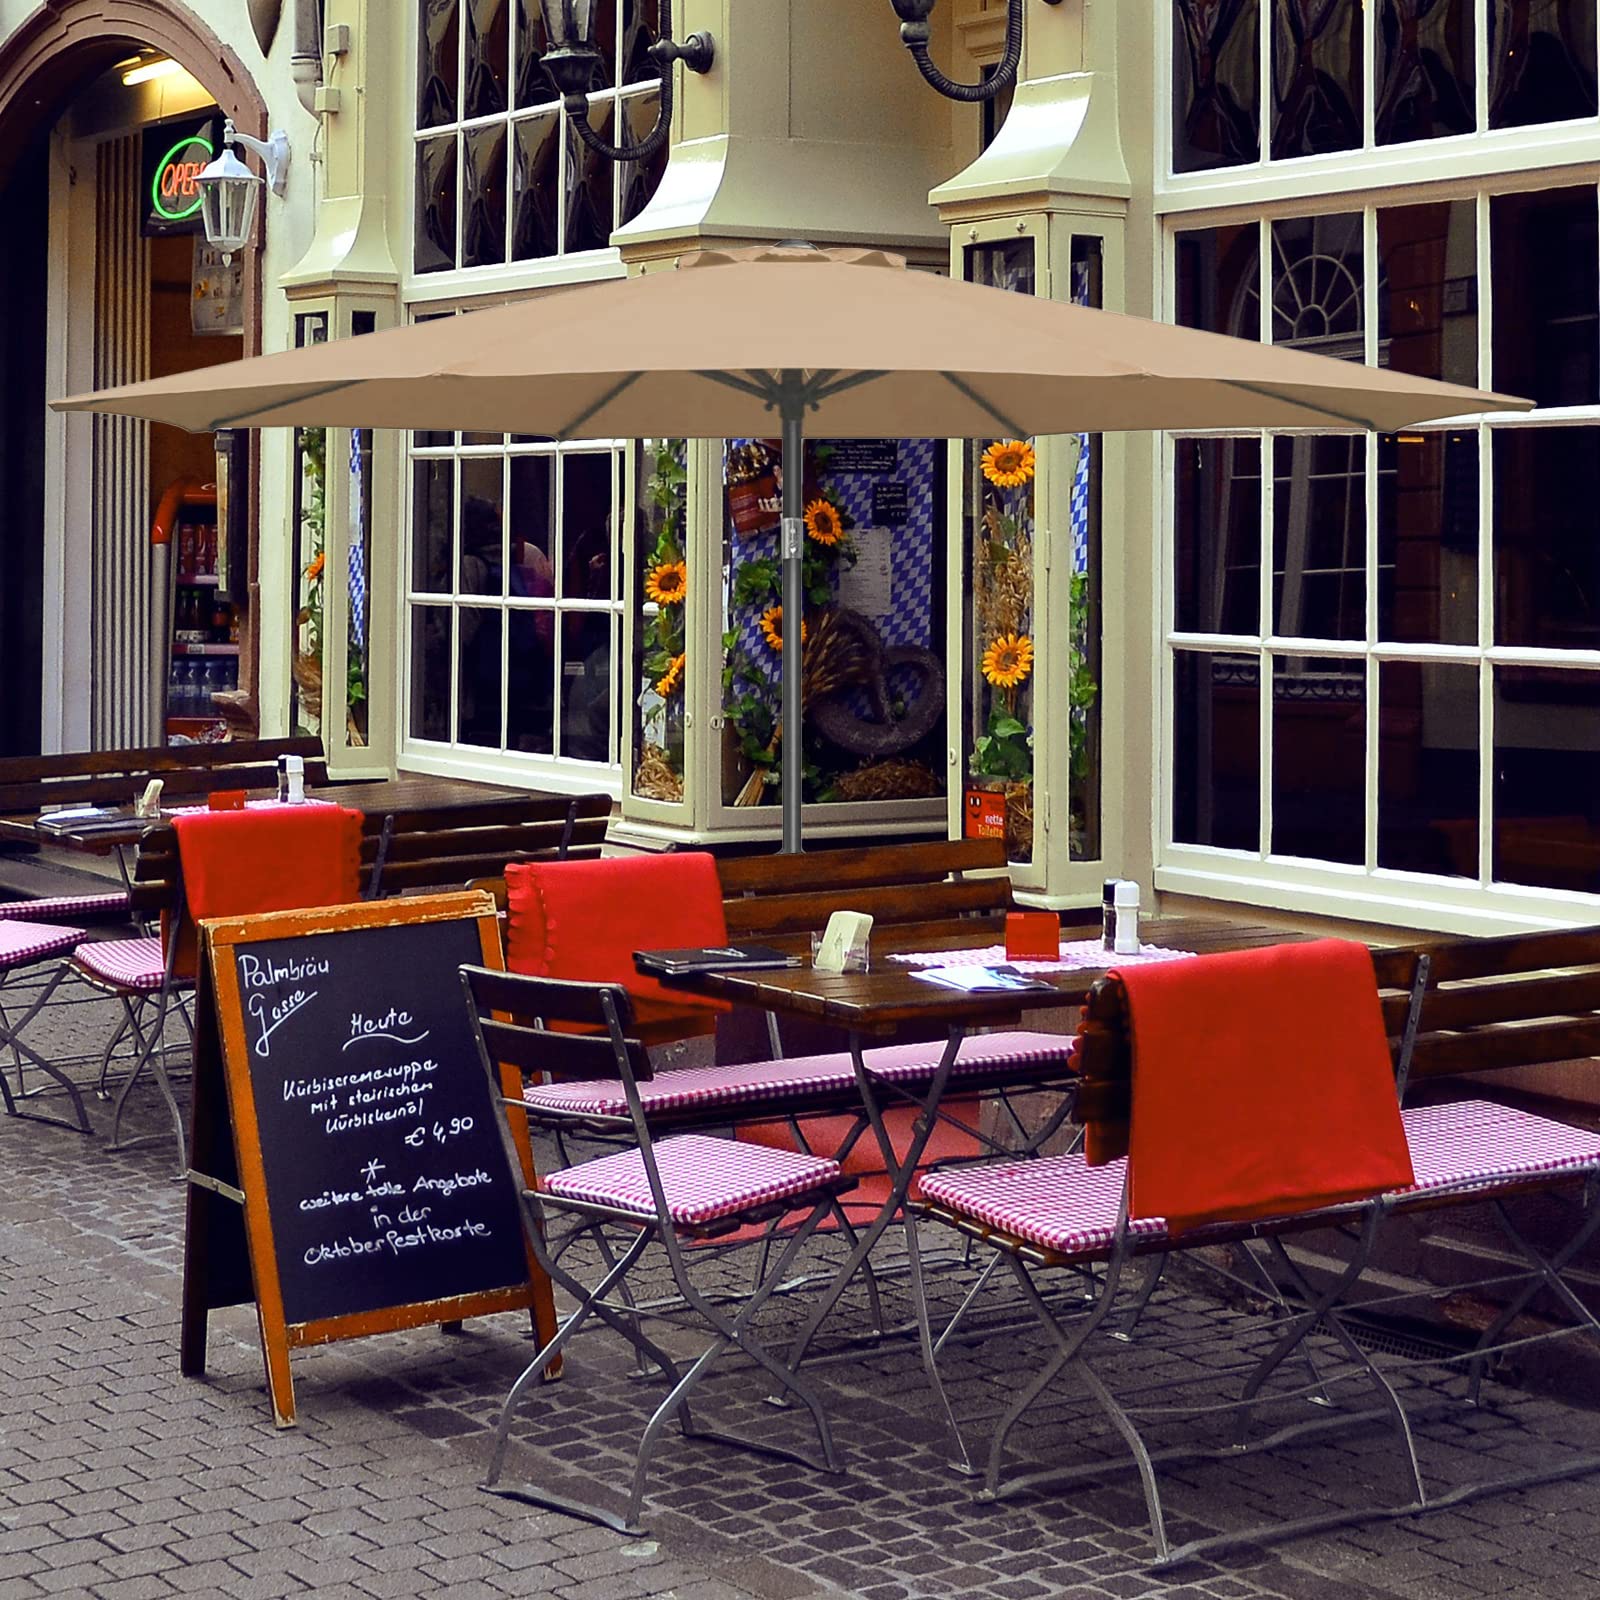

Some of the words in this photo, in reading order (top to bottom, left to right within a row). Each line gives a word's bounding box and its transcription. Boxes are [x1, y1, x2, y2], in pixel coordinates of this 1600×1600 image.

[238, 954, 329, 989] Palmbräu
[249, 989, 318, 1056] Gasse
[351, 1008, 413, 1036] Heute
[404, 1126, 426, 1147] €
[432, 1116, 474, 1144] 4,90
[299, 1191, 364, 1211] weitere
[365, 1181, 406, 1197] tolle
[412, 1168, 493, 1197] Angebote
[370, 1205, 391, 1229] in
[398, 1204, 432, 1224] der
